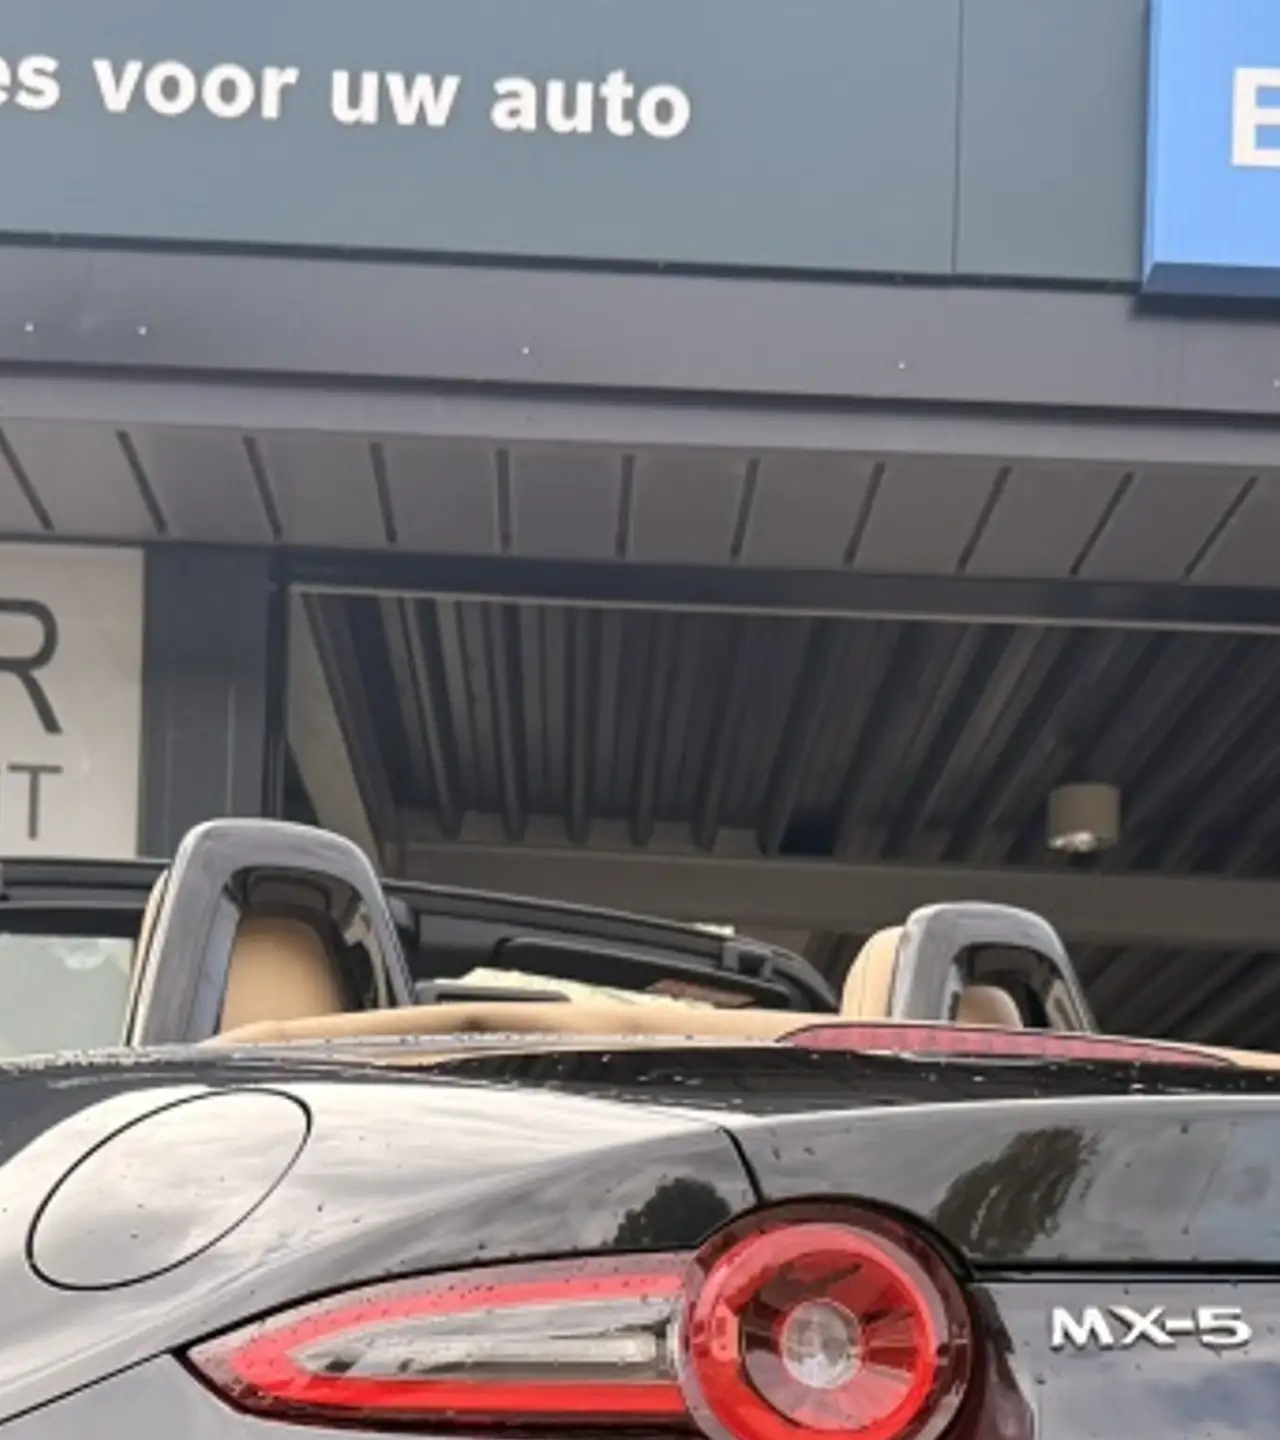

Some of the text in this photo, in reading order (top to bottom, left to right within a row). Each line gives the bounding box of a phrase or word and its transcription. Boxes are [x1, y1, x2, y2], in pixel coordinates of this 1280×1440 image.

[93, 58, 300, 118] voor
[331, 68, 460, 126] uw
[490, 70, 691, 138] auto
[1051, 1306, 1253, 1350] MX-5
